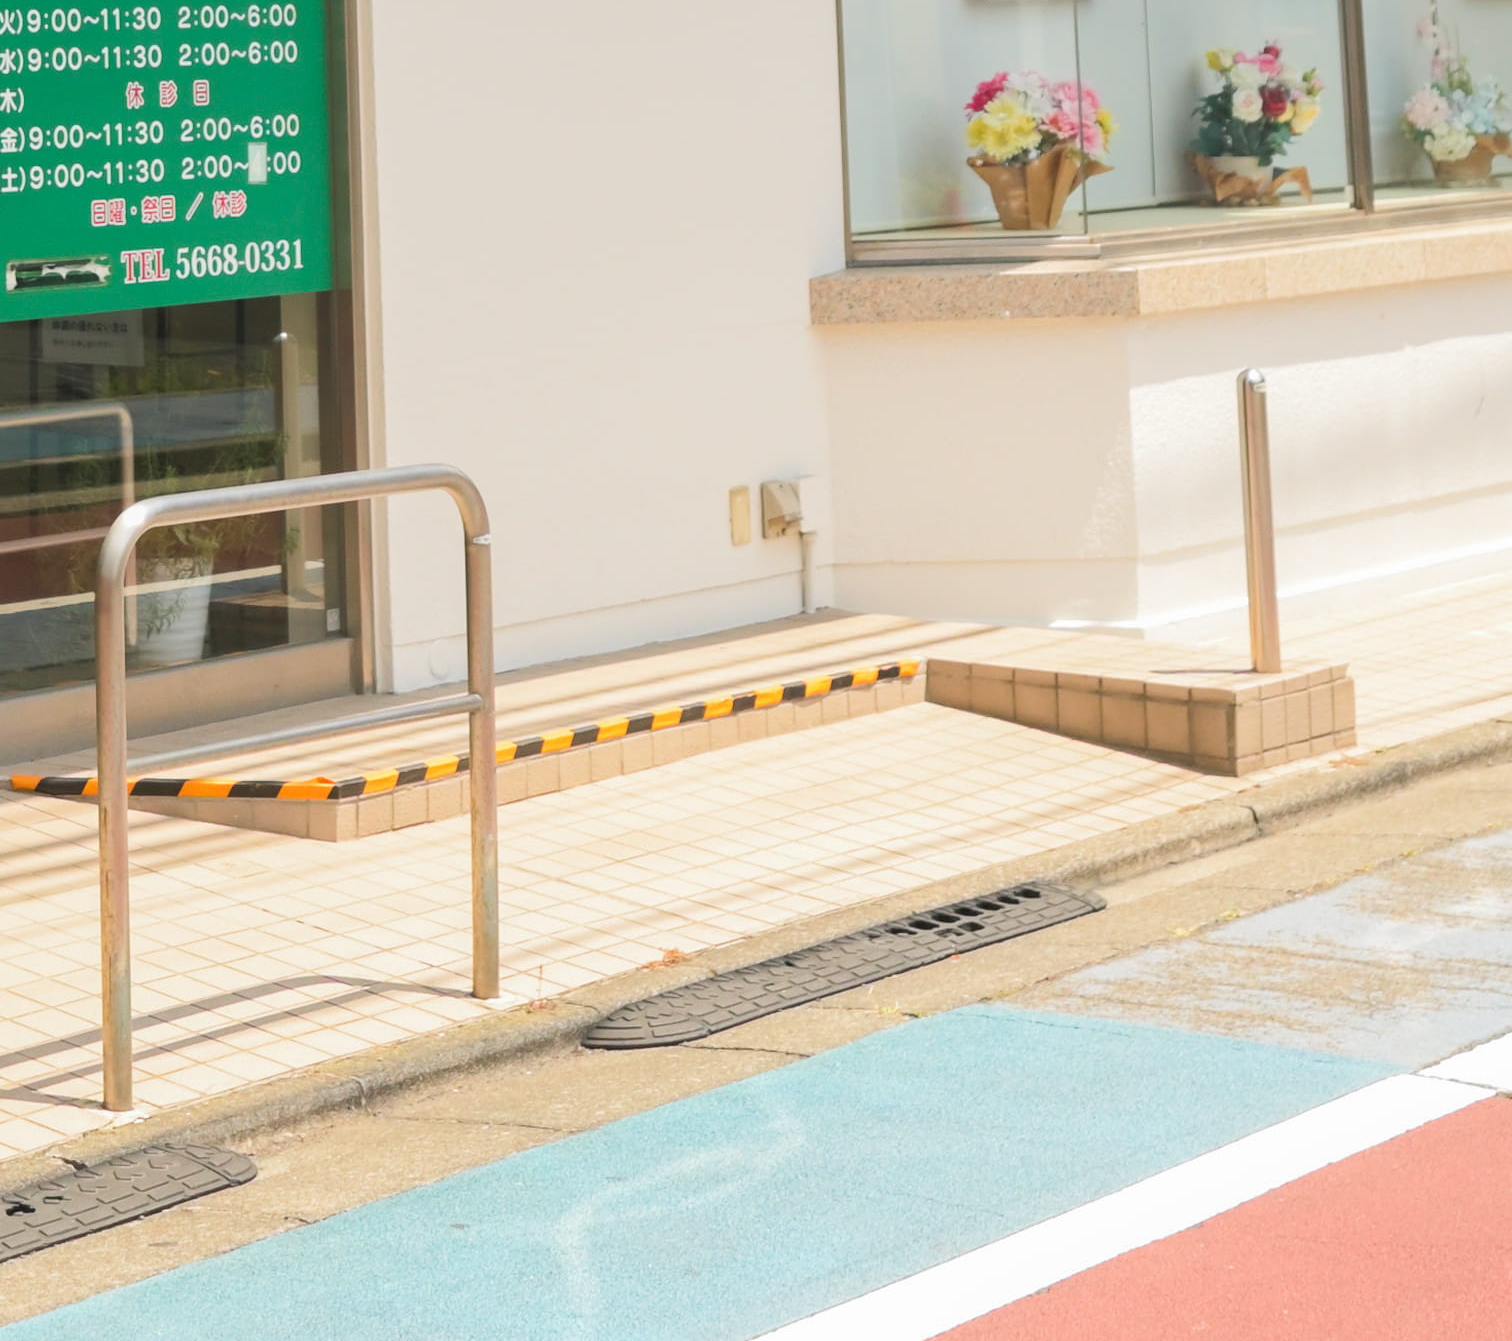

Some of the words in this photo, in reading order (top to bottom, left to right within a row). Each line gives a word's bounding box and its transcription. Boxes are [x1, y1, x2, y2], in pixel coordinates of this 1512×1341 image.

[125, 79, 210, 109] 休診日
[212, 190, 248, 217] 休診
[120, 248, 171, 284] TEL
[176, 239, 305, 280] 5668-0331
